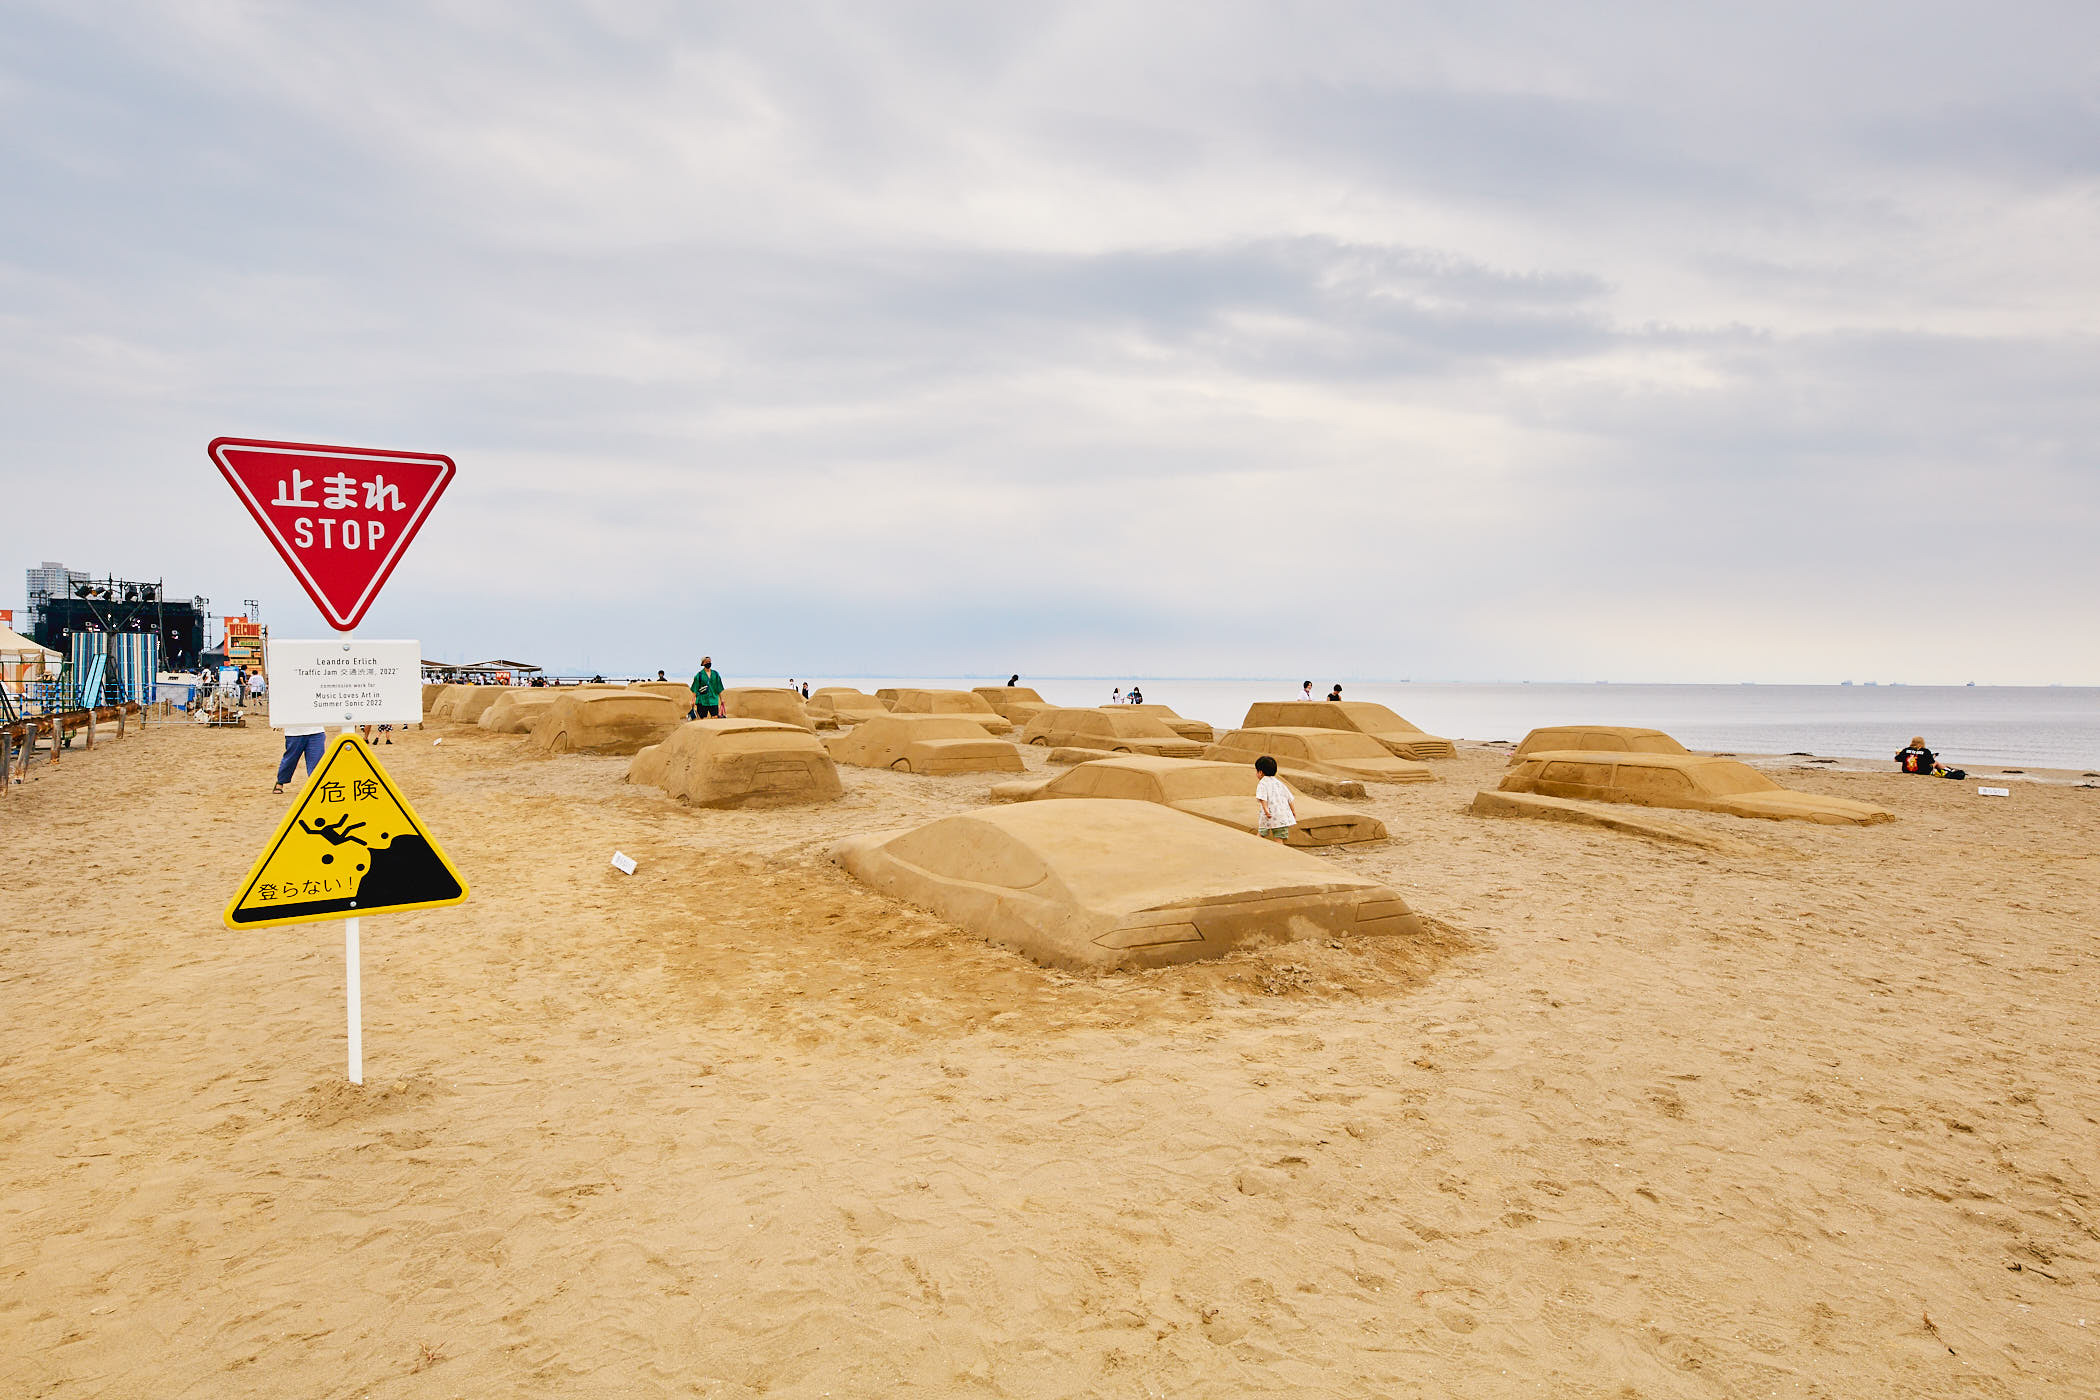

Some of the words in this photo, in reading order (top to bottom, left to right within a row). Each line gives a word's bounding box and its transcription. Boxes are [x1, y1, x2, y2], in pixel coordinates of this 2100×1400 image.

[271, 468, 407, 512] 止まれ
[294, 517, 386, 551] STOP
[229, 623, 261, 636] WELCOME
[353, 657, 377, 665] Erlich
[323, 668, 338, 676] Jam
[366, 699, 383, 707] 2022
[320, 778, 379, 804] 危険
